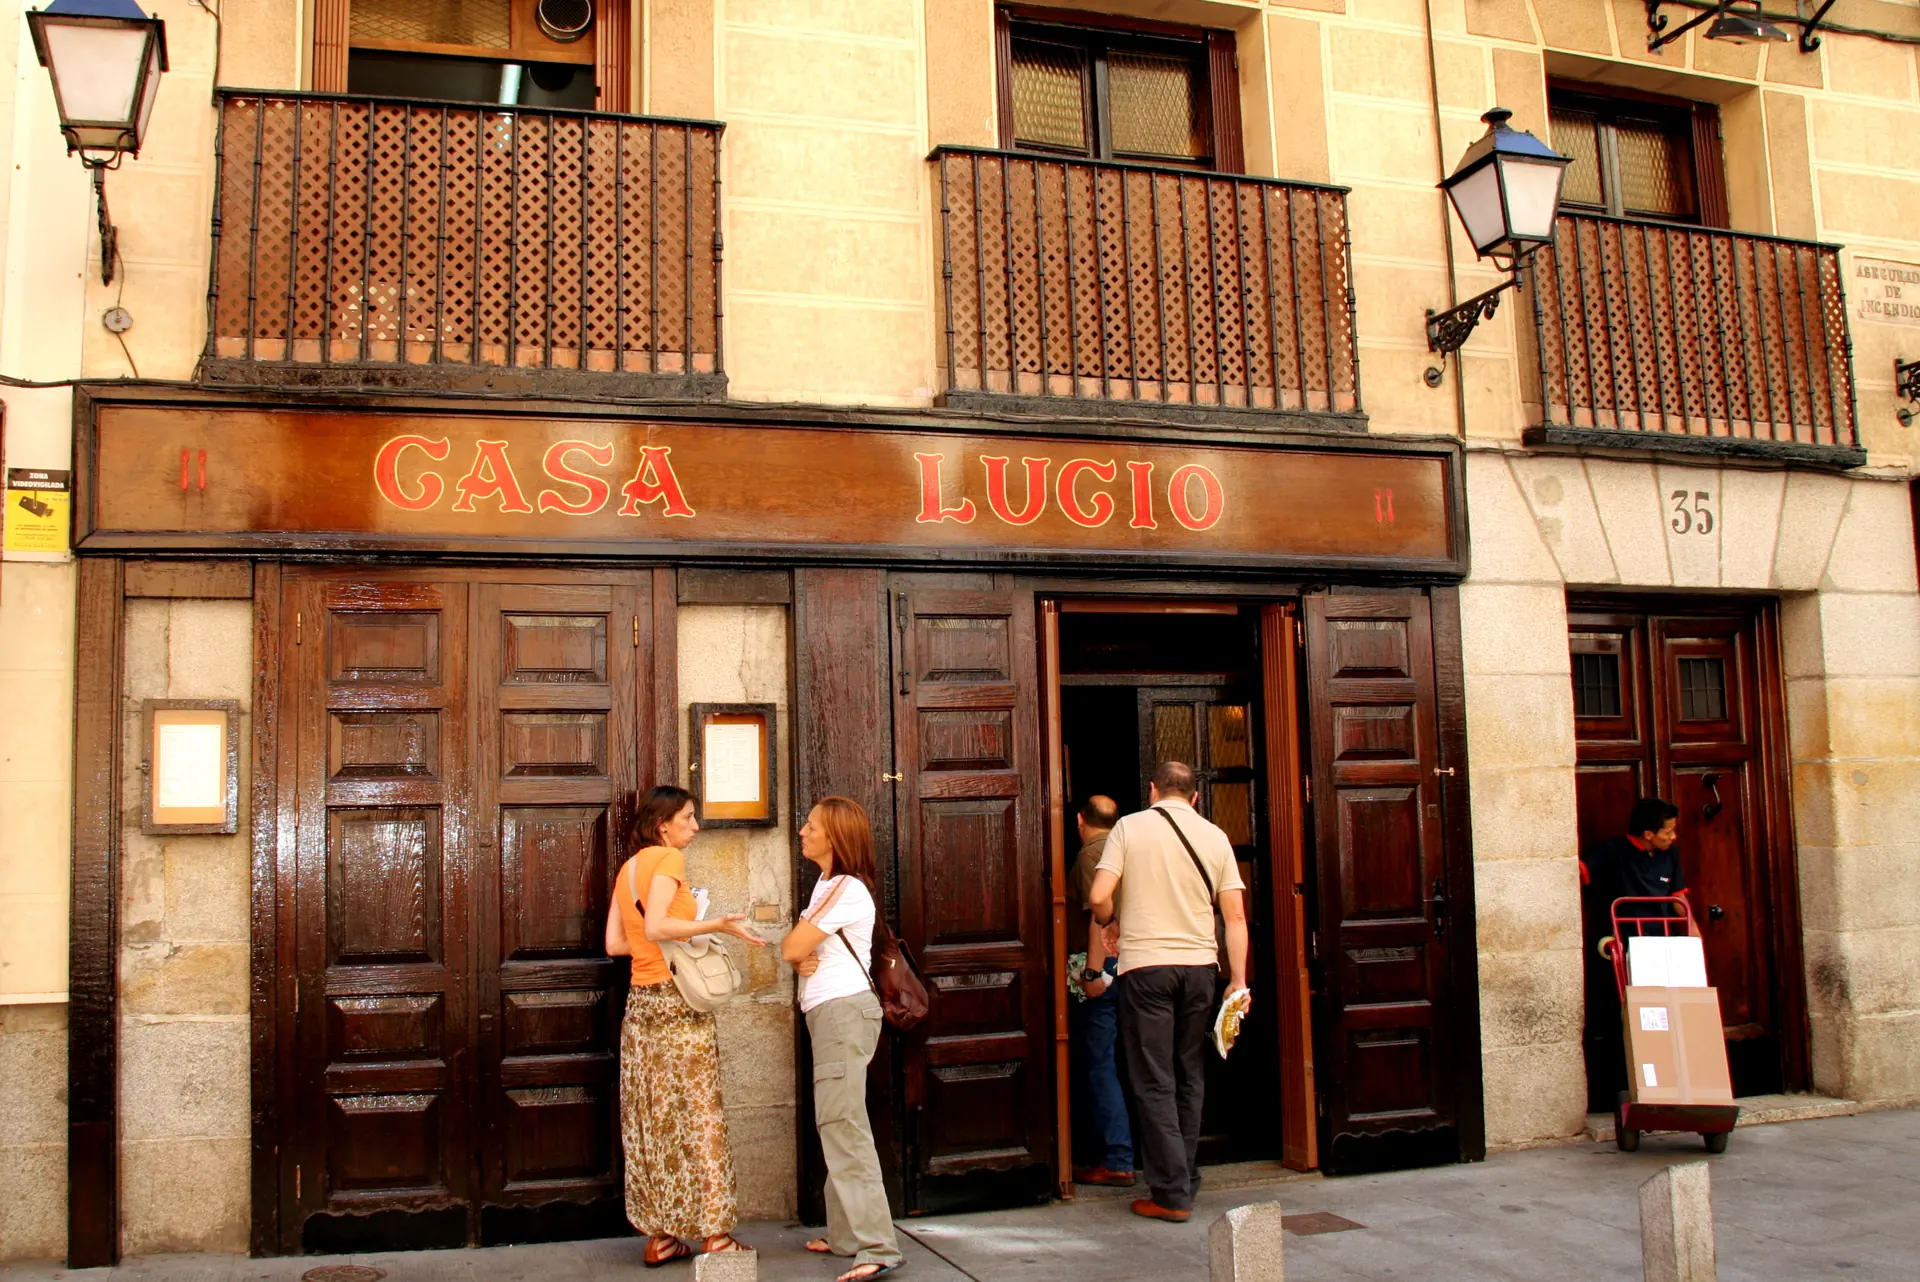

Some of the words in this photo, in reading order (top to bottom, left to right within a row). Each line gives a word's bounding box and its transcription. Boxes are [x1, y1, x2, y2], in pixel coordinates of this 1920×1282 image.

[1884, 285, 1901, 299] DE
[29, 472, 49, 480] ZONA
[374, 434, 696, 518] CASA
[913, 452, 1225, 531] LUCIO
[12, 480, 65, 489] VIDEOVIGILADA
[1670, 489, 1714, 535] 35
